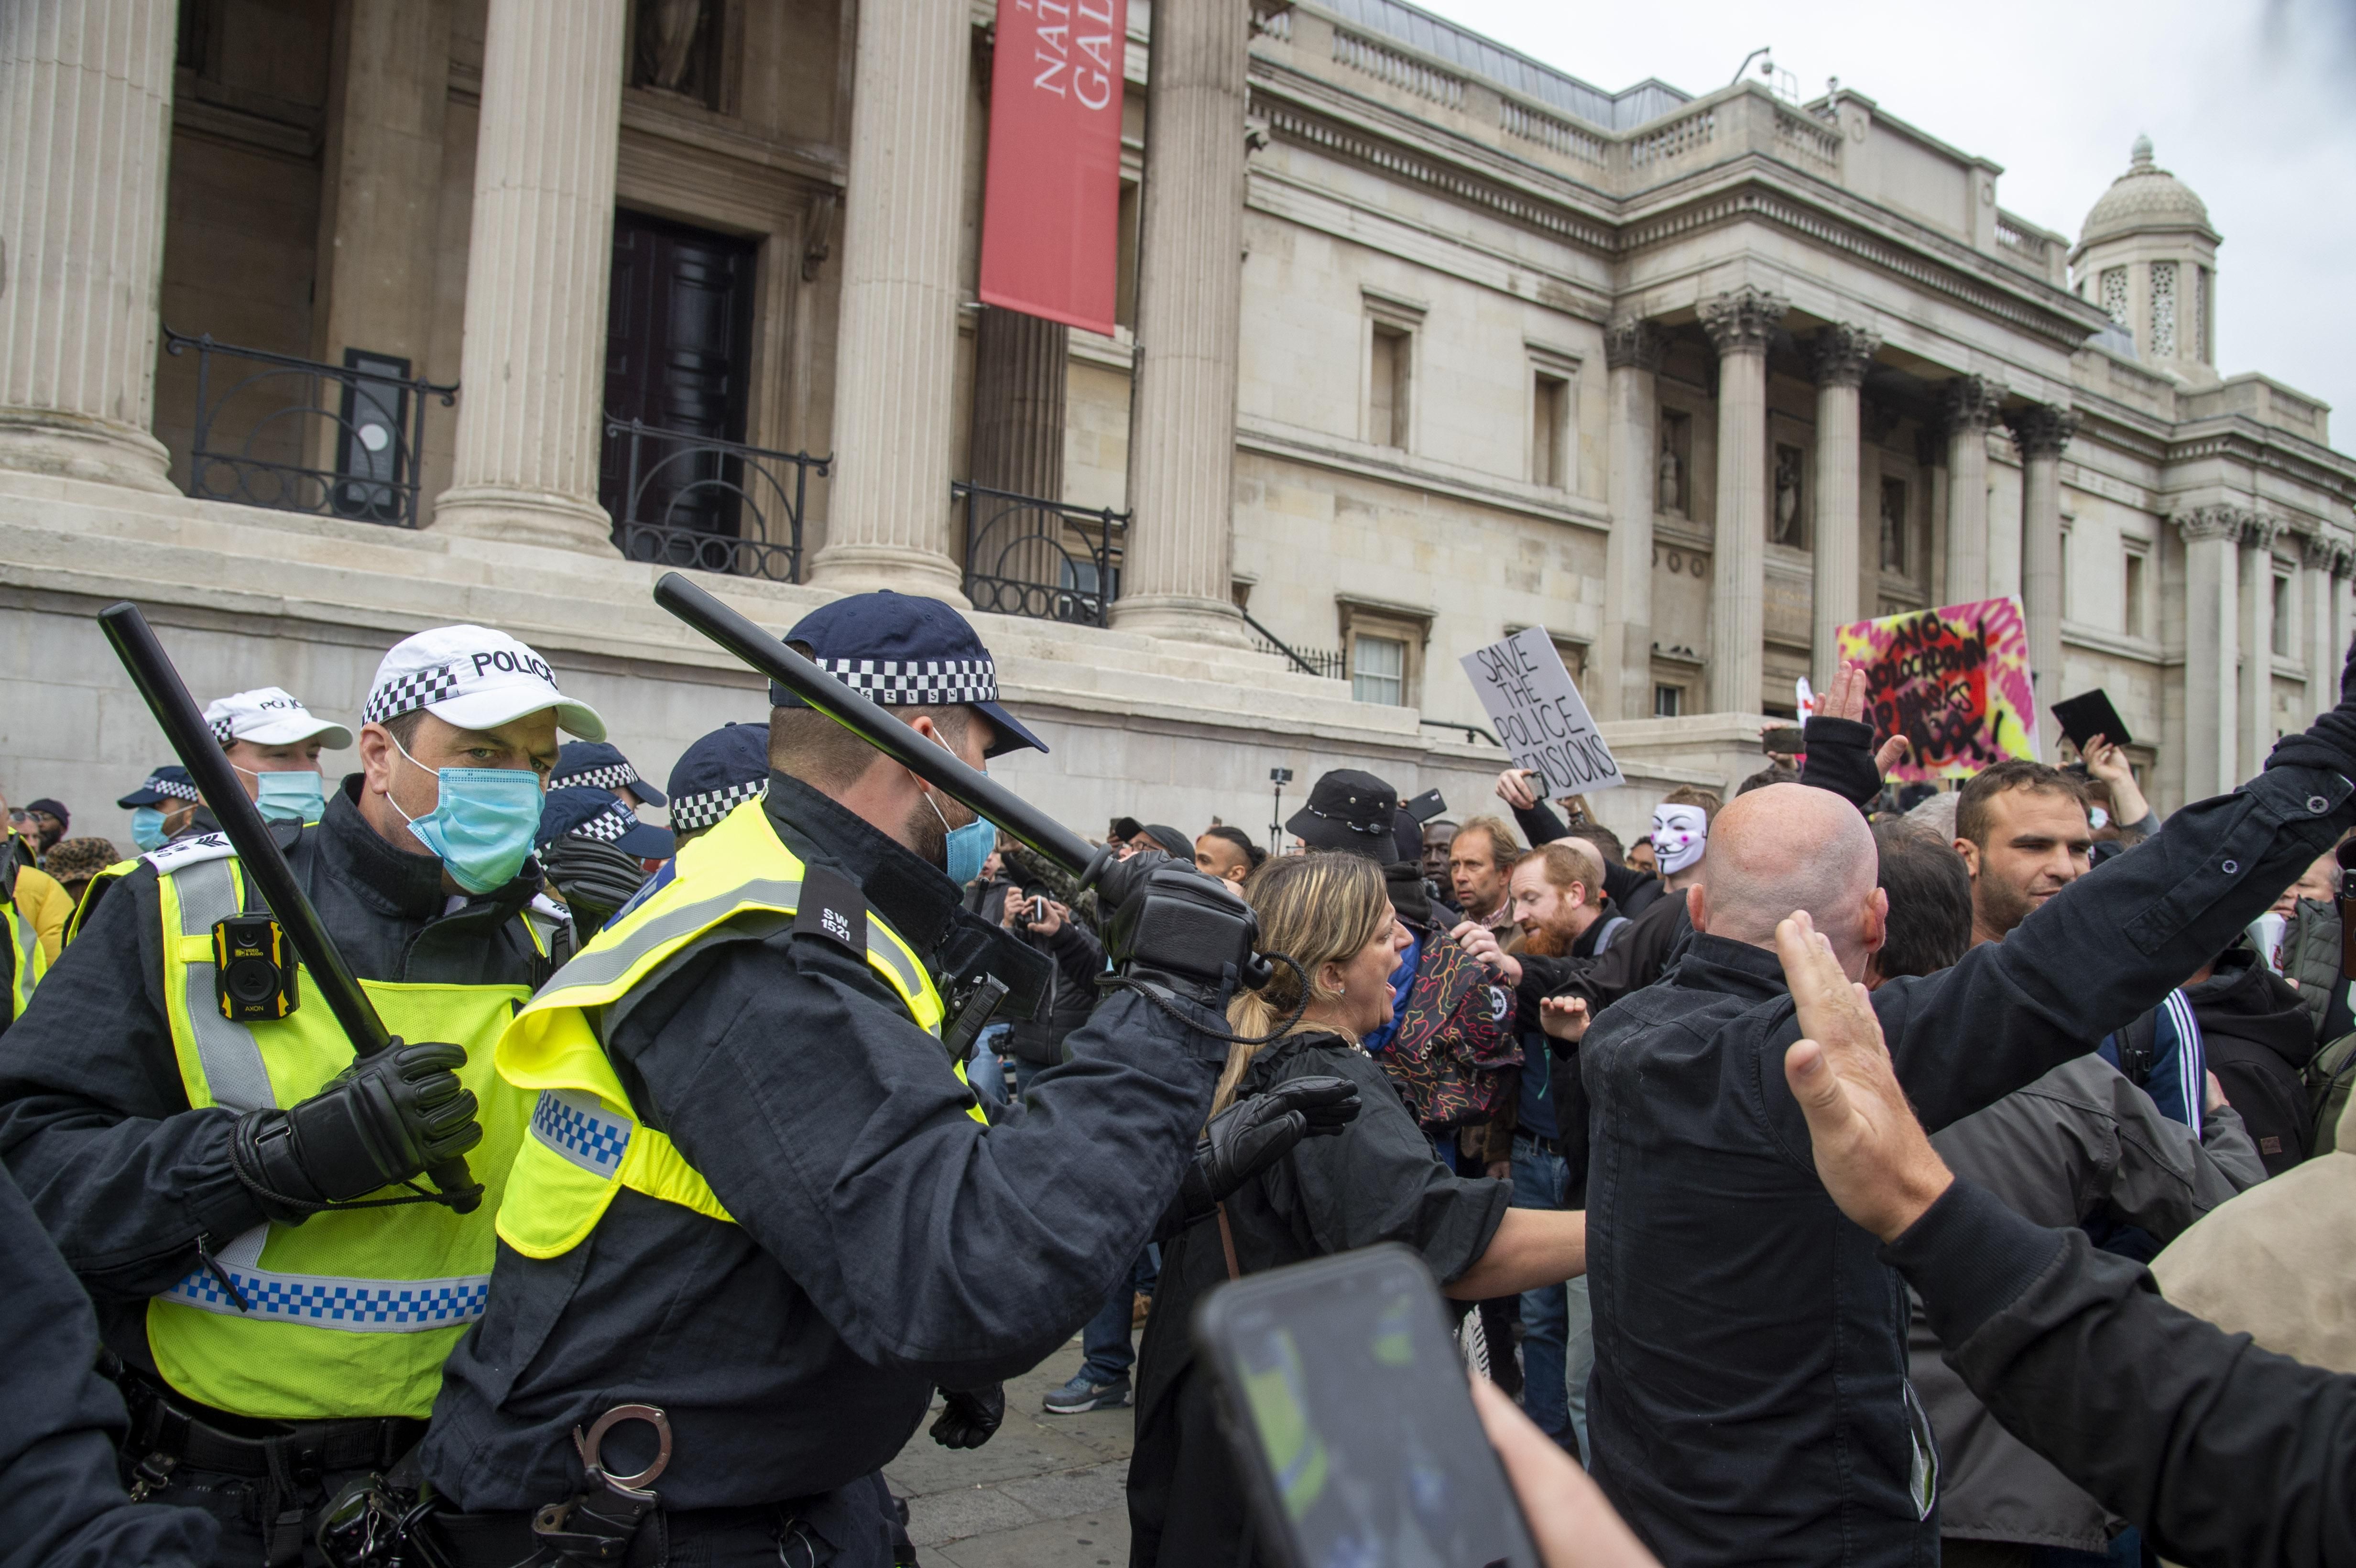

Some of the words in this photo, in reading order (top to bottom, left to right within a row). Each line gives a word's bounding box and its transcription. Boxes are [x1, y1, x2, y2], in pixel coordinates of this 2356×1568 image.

[471, 651, 558, 691] POLICE
[1476, 635, 1538, 683] SAVE
[1497, 674, 1542, 709] THE
[1494, 696, 1585, 751] POLICE
[821, 919, 851, 942] 1521
[823, 908, 849, 928] SW
